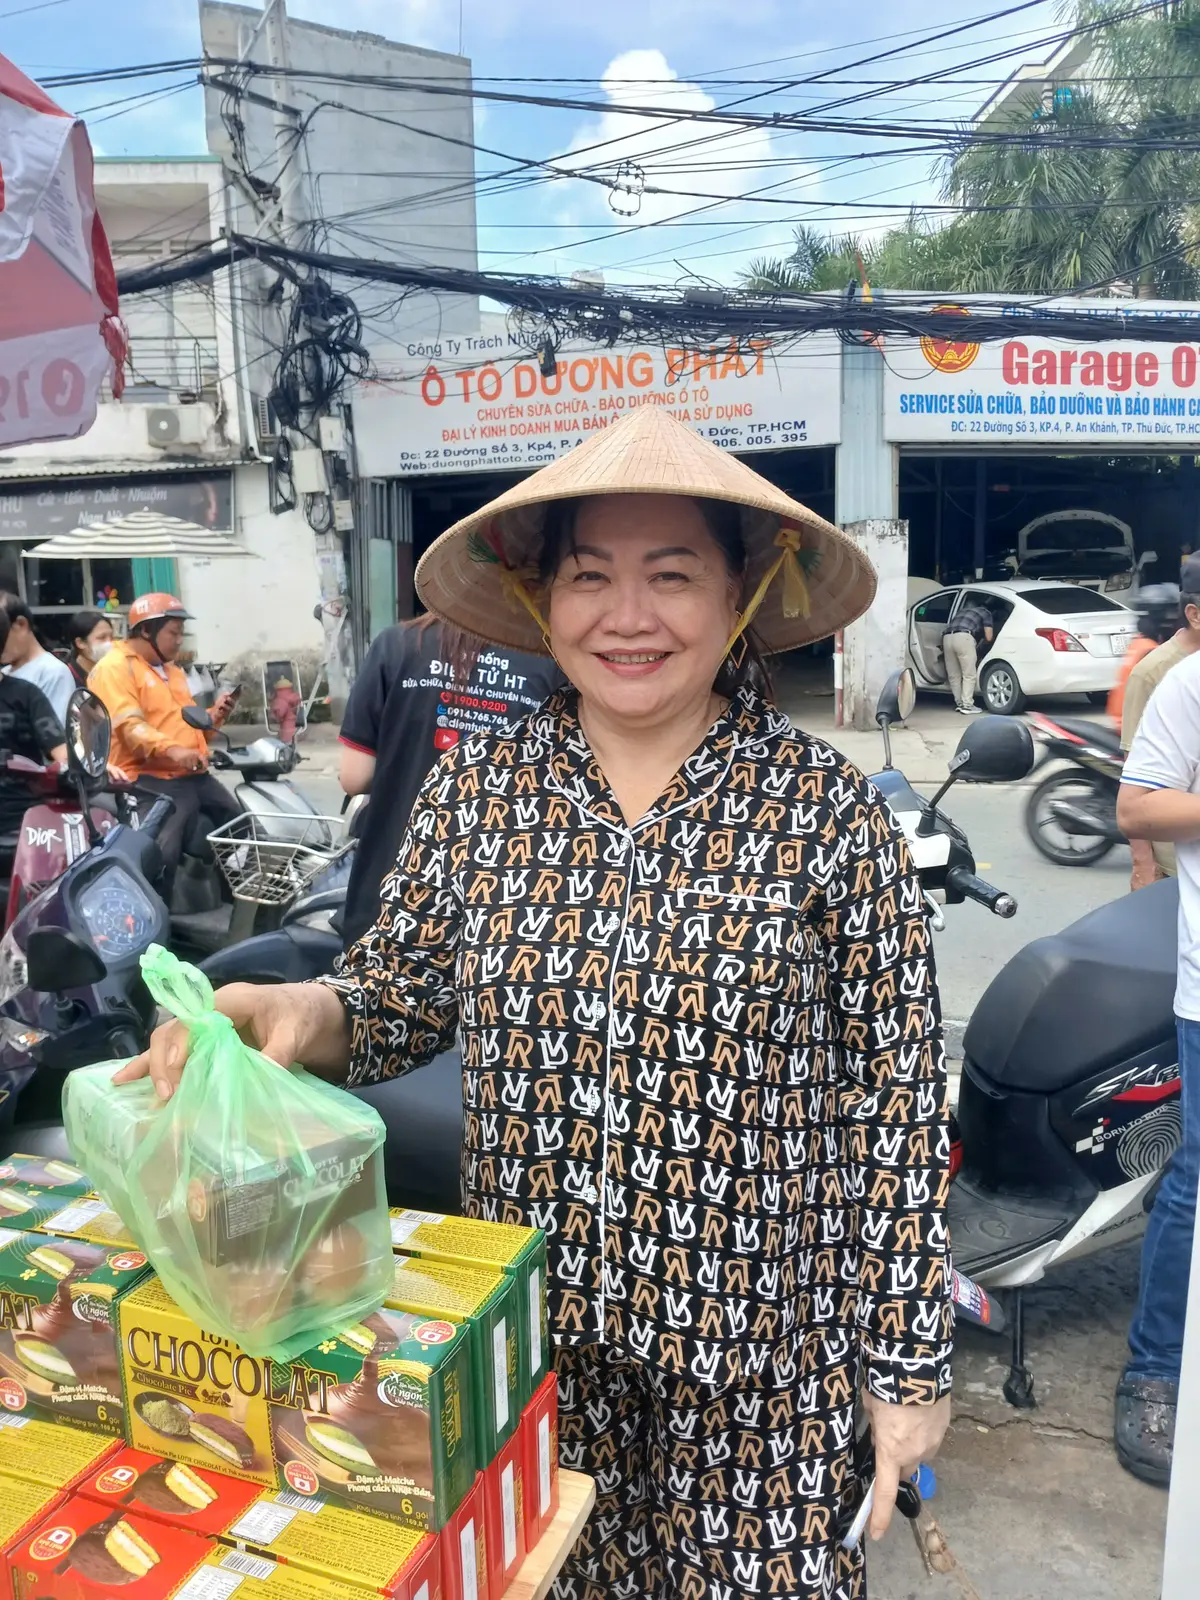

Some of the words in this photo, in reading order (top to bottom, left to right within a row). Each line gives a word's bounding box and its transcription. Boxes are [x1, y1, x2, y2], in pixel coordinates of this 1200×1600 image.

[446, 340, 461, 355] Ty
[465, 335, 503, 350] Trách
[1002, 341, 1159, 391] Garage
[421, 366, 446, 406] Ô
[455, 360, 503, 403] TÔ
[555, 398, 590, 415] CHỮA
[599, 395, 624, 411] BẢO
[693, 388, 709, 402] TÔ
[900, 394, 955, 413] SERVICE
[958, 389, 983, 414] SỬA
[1031, 390, 1055, 414] BẢO
[1060, 392, 1102, 415] DƯỠNG
[1106, 393, 1122, 415] VÀ
[1125, 392, 1150, 415] BẢO
[1153, 394, 1185, 417] HÀNH
[442, 427, 460, 443] ĐẠI
[464, 424, 476, 440] LÝ
[480, 424, 506, 438] KINH
[510, 422, 550, 437] DOANH
[554, 418, 582, 433] MUA
[583, 416, 607, 430] BÁN
[716, 403, 753, 421] DỤNG
[951, 421, 967, 433] ĐC:
[970, 421, 981, 433] 22
[1076, 422, 1087, 433] An
[425, 450, 440, 459] 22
[748, 420, 806, 434] TP.HCM
[781, 431, 808, 443] 395
[477, 666, 499, 685] TỬ
[504, 673, 527, 690] HT
[454, 695, 507, 712] 1900.9200
[1096, 1126, 1127, 1142] BORN
[127, 1325, 339, 1416] CHOCOLAT
[136, 1371, 177, 1392] Chocolate
[178, 1382, 192, 1396] Pie
[387, 1385, 397, 1398] Vị
[399, 1390, 423, 1402] ngon
[97, 1405, 107, 1421] 6
[372, 1483, 390, 1493] cách
[384, 1475, 415, 1486] Matcha
[401, 1498, 413, 1515] 6
